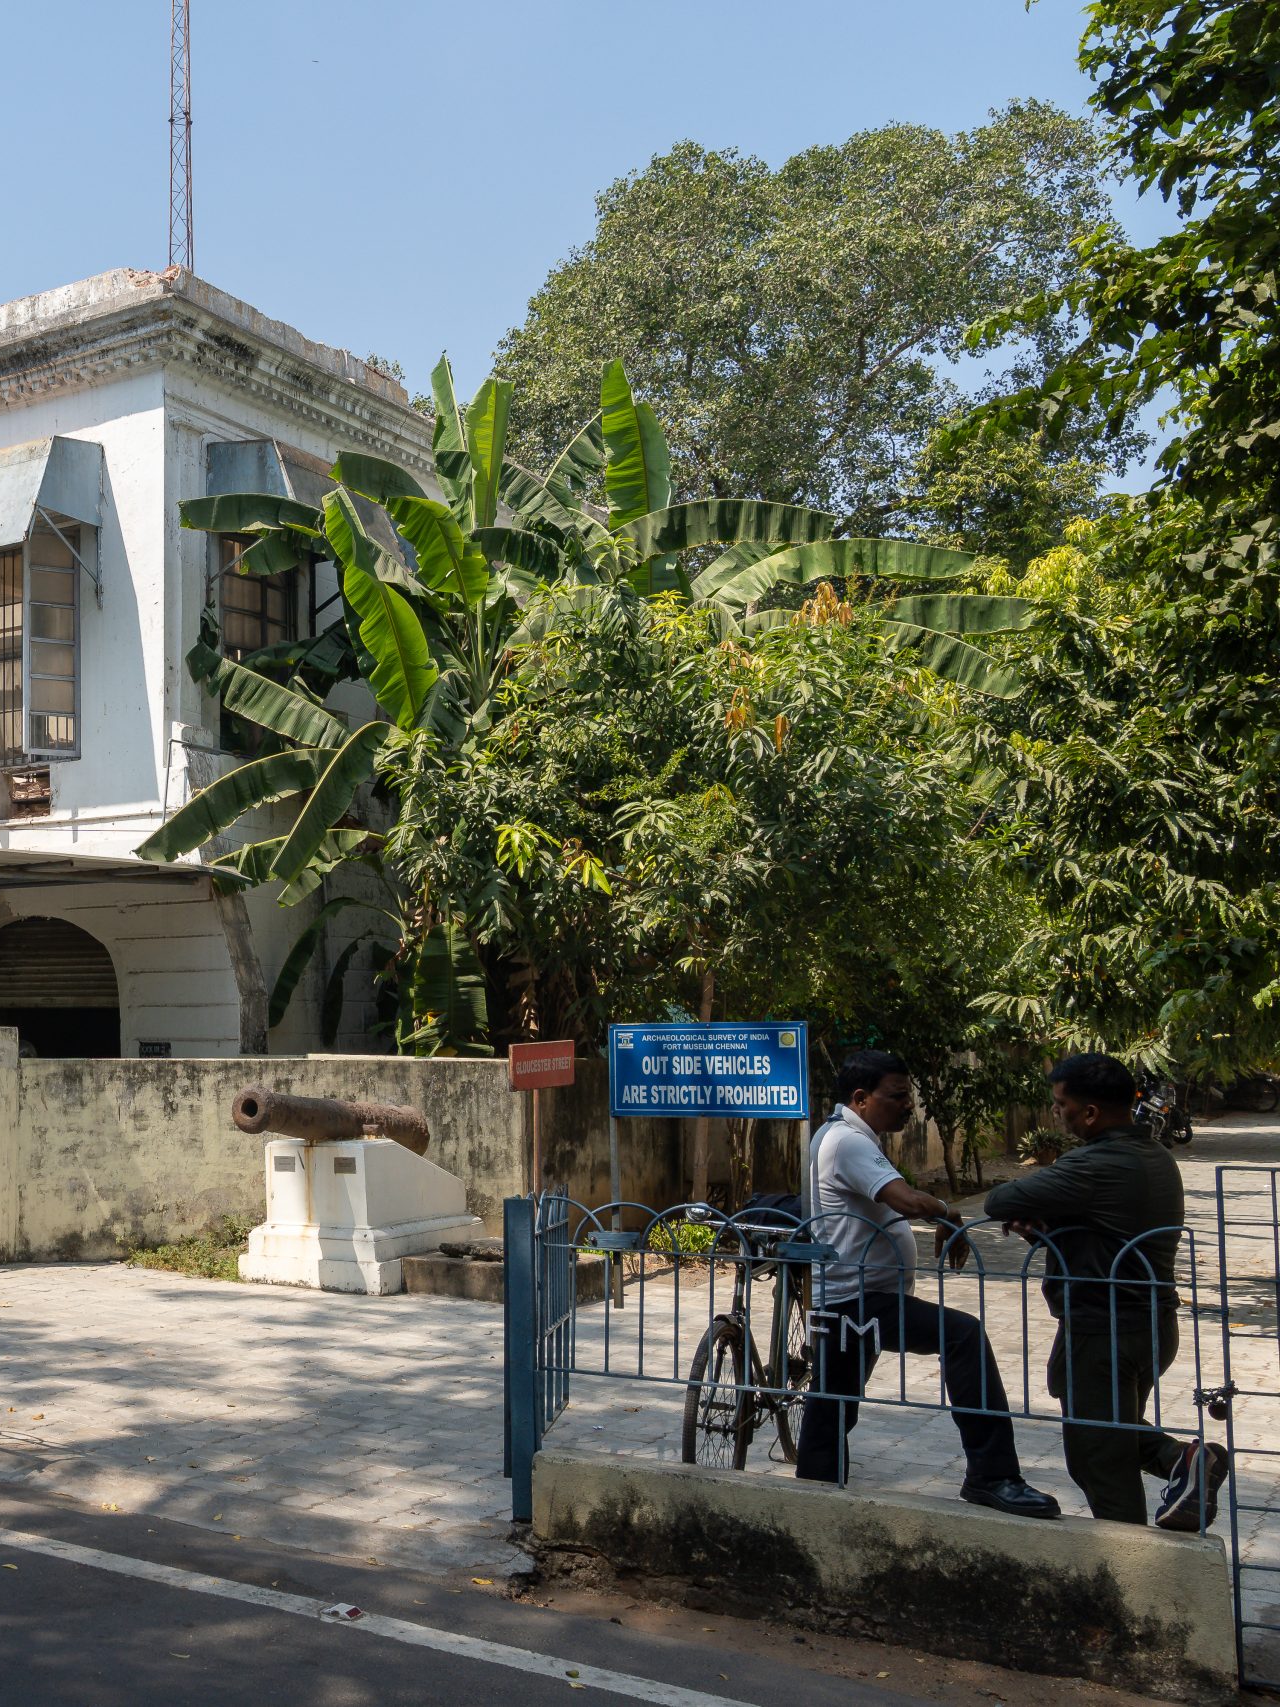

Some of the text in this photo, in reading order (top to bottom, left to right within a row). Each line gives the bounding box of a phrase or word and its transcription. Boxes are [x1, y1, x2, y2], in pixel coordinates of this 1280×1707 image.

[641, 1033, 770, 1042] ARCHAEOLOGICAL SURVEY OF INDIA
[515, 1056, 572, 1074] GLOUCESTER STREET
[642, 1055, 771, 1075] OUT SIDE VEHICLES
[622, 1085, 798, 1106] ARE STRICTLY PROHIBITED
[805, 1310, 881, 1356] FM
